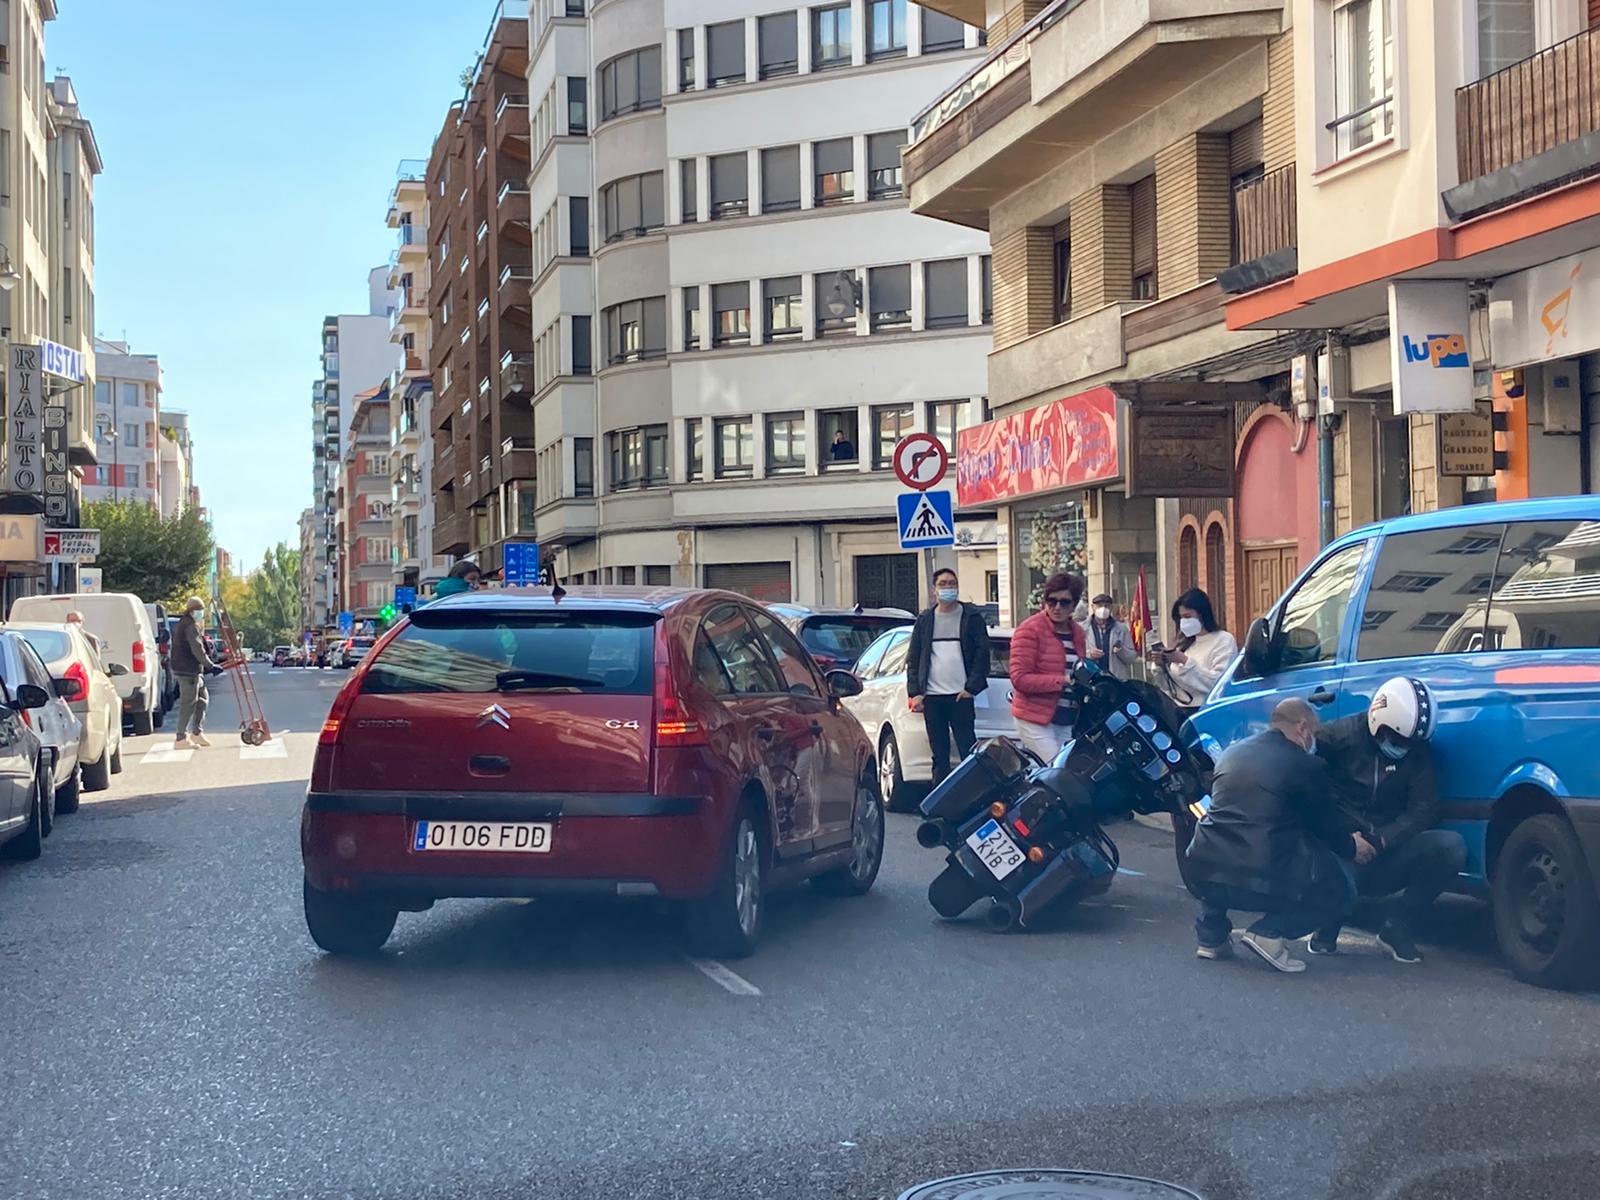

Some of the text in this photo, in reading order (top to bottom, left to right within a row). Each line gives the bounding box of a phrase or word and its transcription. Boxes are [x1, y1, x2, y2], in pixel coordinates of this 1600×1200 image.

[1402, 335, 1466, 368] lupa
[14, 347, 36, 490] RIALTO
[45, 408, 66, 516] BINGO
[604, 719, 640, 730] C4
[431, 824, 546, 848] 0106 FDD
[988, 831, 1021, 866] 2178
[976, 839, 1003, 868] KYB
